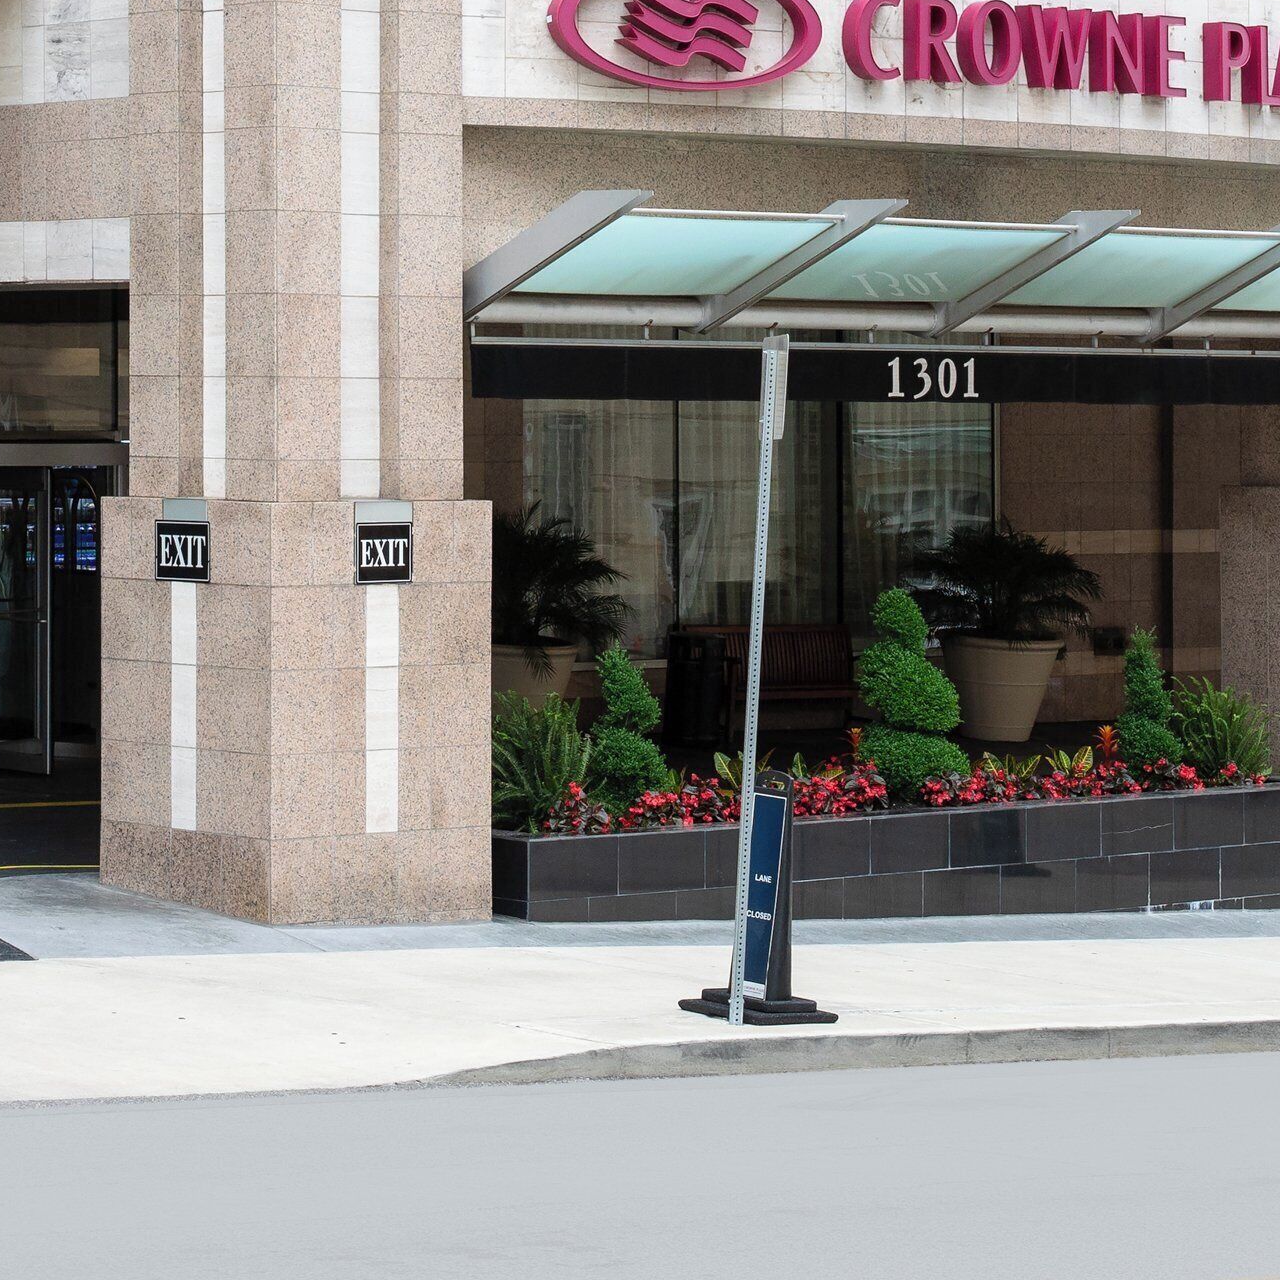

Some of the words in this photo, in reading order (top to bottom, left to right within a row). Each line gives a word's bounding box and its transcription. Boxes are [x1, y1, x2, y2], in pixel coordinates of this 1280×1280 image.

[887, 356, 980, 400] 1301
[159, 534, 206, 569] EXIT
[360, 538, 408, 568] EXIT
[754, 873, 772, 884] LANE
[746, 909, 772, 921] CLOSED
